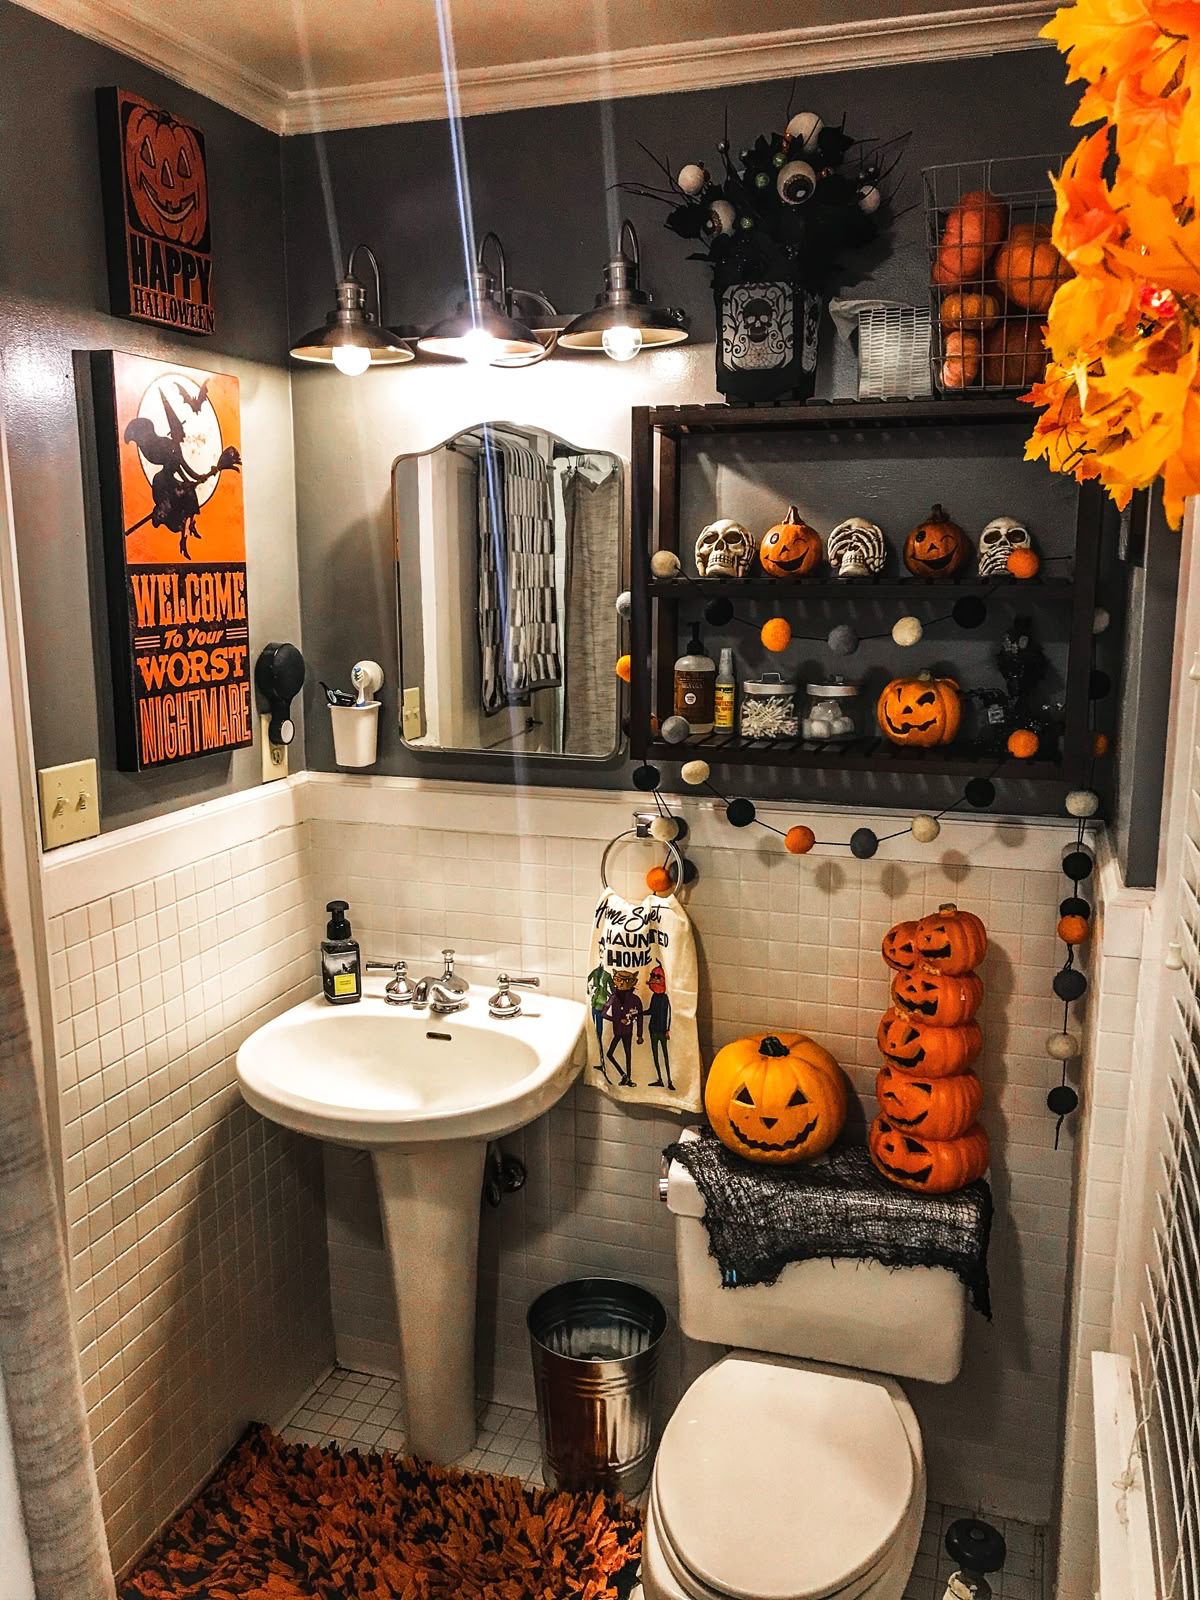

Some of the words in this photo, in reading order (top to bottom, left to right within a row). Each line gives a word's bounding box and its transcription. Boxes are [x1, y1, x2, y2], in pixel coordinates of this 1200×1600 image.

[130, 233, 212, 306] HAPPY
[134, 289, 215, 333] HALLOWEEN
[130, 571, 247, 628] WELCOME
[164, 629, 184, 649] To
[186, 628, 225, 647] Your
[136, 645, 248, 691] WORST
[139, 682, 252, 765] NIGHTMARE
[595, 898, 628, 929] Home
[624, 906, 670, 933] Swet
[606, 928, 669, 948] HAUNTED
[607, 948, 653, 968] HOME
